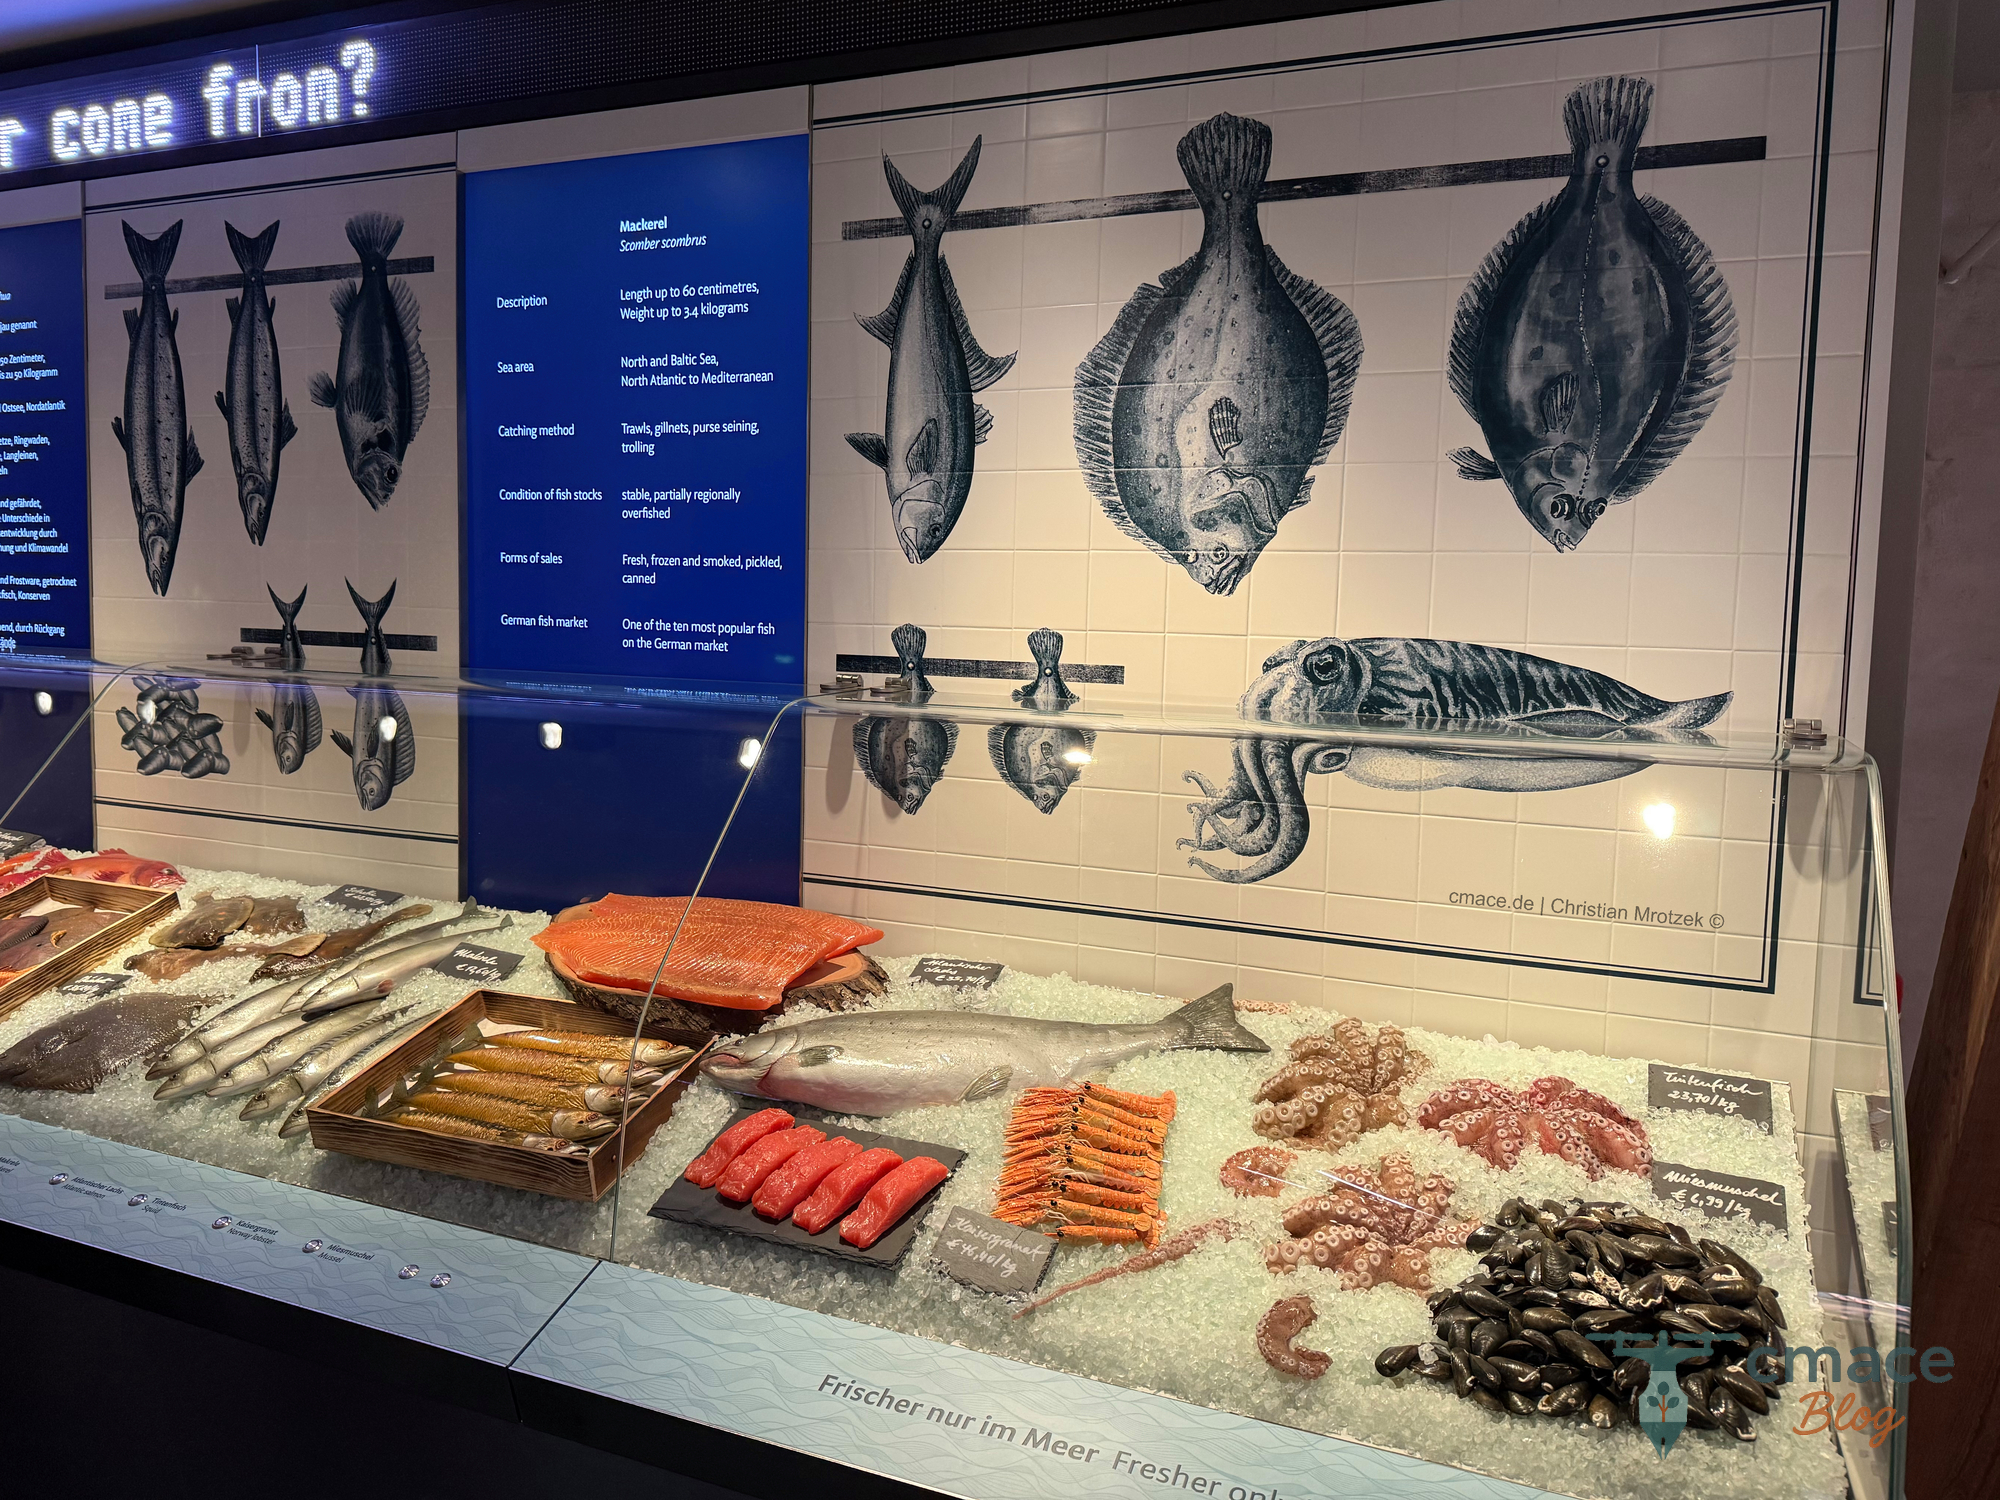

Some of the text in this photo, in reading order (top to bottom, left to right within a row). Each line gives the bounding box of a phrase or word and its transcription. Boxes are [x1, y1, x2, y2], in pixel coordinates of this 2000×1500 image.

[51, 92, 174, 160] come
[202, 39, 376, 138] from?
[619, 216, 668, 233] Mackerel
[619, 234, 707, 252] Scomber scombrus
[620, 281, 760, 303] Length up to 60 centimetres,
[496, 295, 548, 310] Description
[620, 302, 749, 323] Weight up to 3.4 kilograms
[10, 320, 38, 333] genannt
[9, 353, 46, 364] Zentimeter,
[620, 352, 719, 369] North and Baltic Sea,
[5, 371, 14, 379] zu
[14, 370, 23, 381] 50
[23, 367, 59, 381] Kilogramm
[497, 361, 535, 374] Sea area
[621, 370, 774, 388] North Atlantic to Mediterranean
[2, 400, 66, 414] Ostsee, Nordatlantik
[498, 423, 575, 440] Catching method
[621, 420, 760, 438] Trawls, gillnets, purse seining,
[14, 434, 50, 448] Ringwaden,
[621, 441, 655, 456] trolling
[3, 450, 39, 463] Langleinen,
[499, 488, 603, 501] Condition of fish stocks
[621, 488, 741, 503] stable, partially regionally
[9, 497, 42, 511] gefährdet,
[2, 512, 51, 523] Unterschiede in
[621, 506, 671, 519] overfished
[39, 528, 58, 538] durch
[15, 542, 28, 553] und
[28, 542, 69, 553] Klimawandel
[500, 552, 563, 565] Forms of sales
[622, 554, 783, 571] Fresh, frozen and smoked, pickled,
[9, 575, 42, 587] Frostware,
[42, 577, 77, 588] getrocknet
[622, 572, 656, 585] canned
[17, 591, 51, 601] Konserven
[500, 614, 588, 629] German fish market
[622, 618, 775, 636] One of the ten most popular fish
[15, 622, 34, 633] durch
[34, 624, 65, 637] Rückgang
[622, 636, 728, 652] on the German market
[1663, 1071, 1764, 1096] Tintenfisch
[1667, 1090, 1740, 1114] 23,70/kg
[71, 1176, 124, 1195] Atlantischer Lachs
[1662, 1170, 1783, 1206] Miesmuschel
[1670, 1189, 1687, 1203] €
[141, 1204, 162, 1215] Squid
[151, 1197, 187, 1212] Tintenfisch
[236, 1219, 279, 1236] Kaisergranat
[226, 1227, 276, 1246] Norway lobster
[949, 1217, 1049, 1262] Kaisergranat
[317, 1251, 345, 1264] Mussel
[326, 1243, 375, 1261] Miesmuschel
[817, 1373, 1223, 1497] Frischer nur im Meer Fresher
